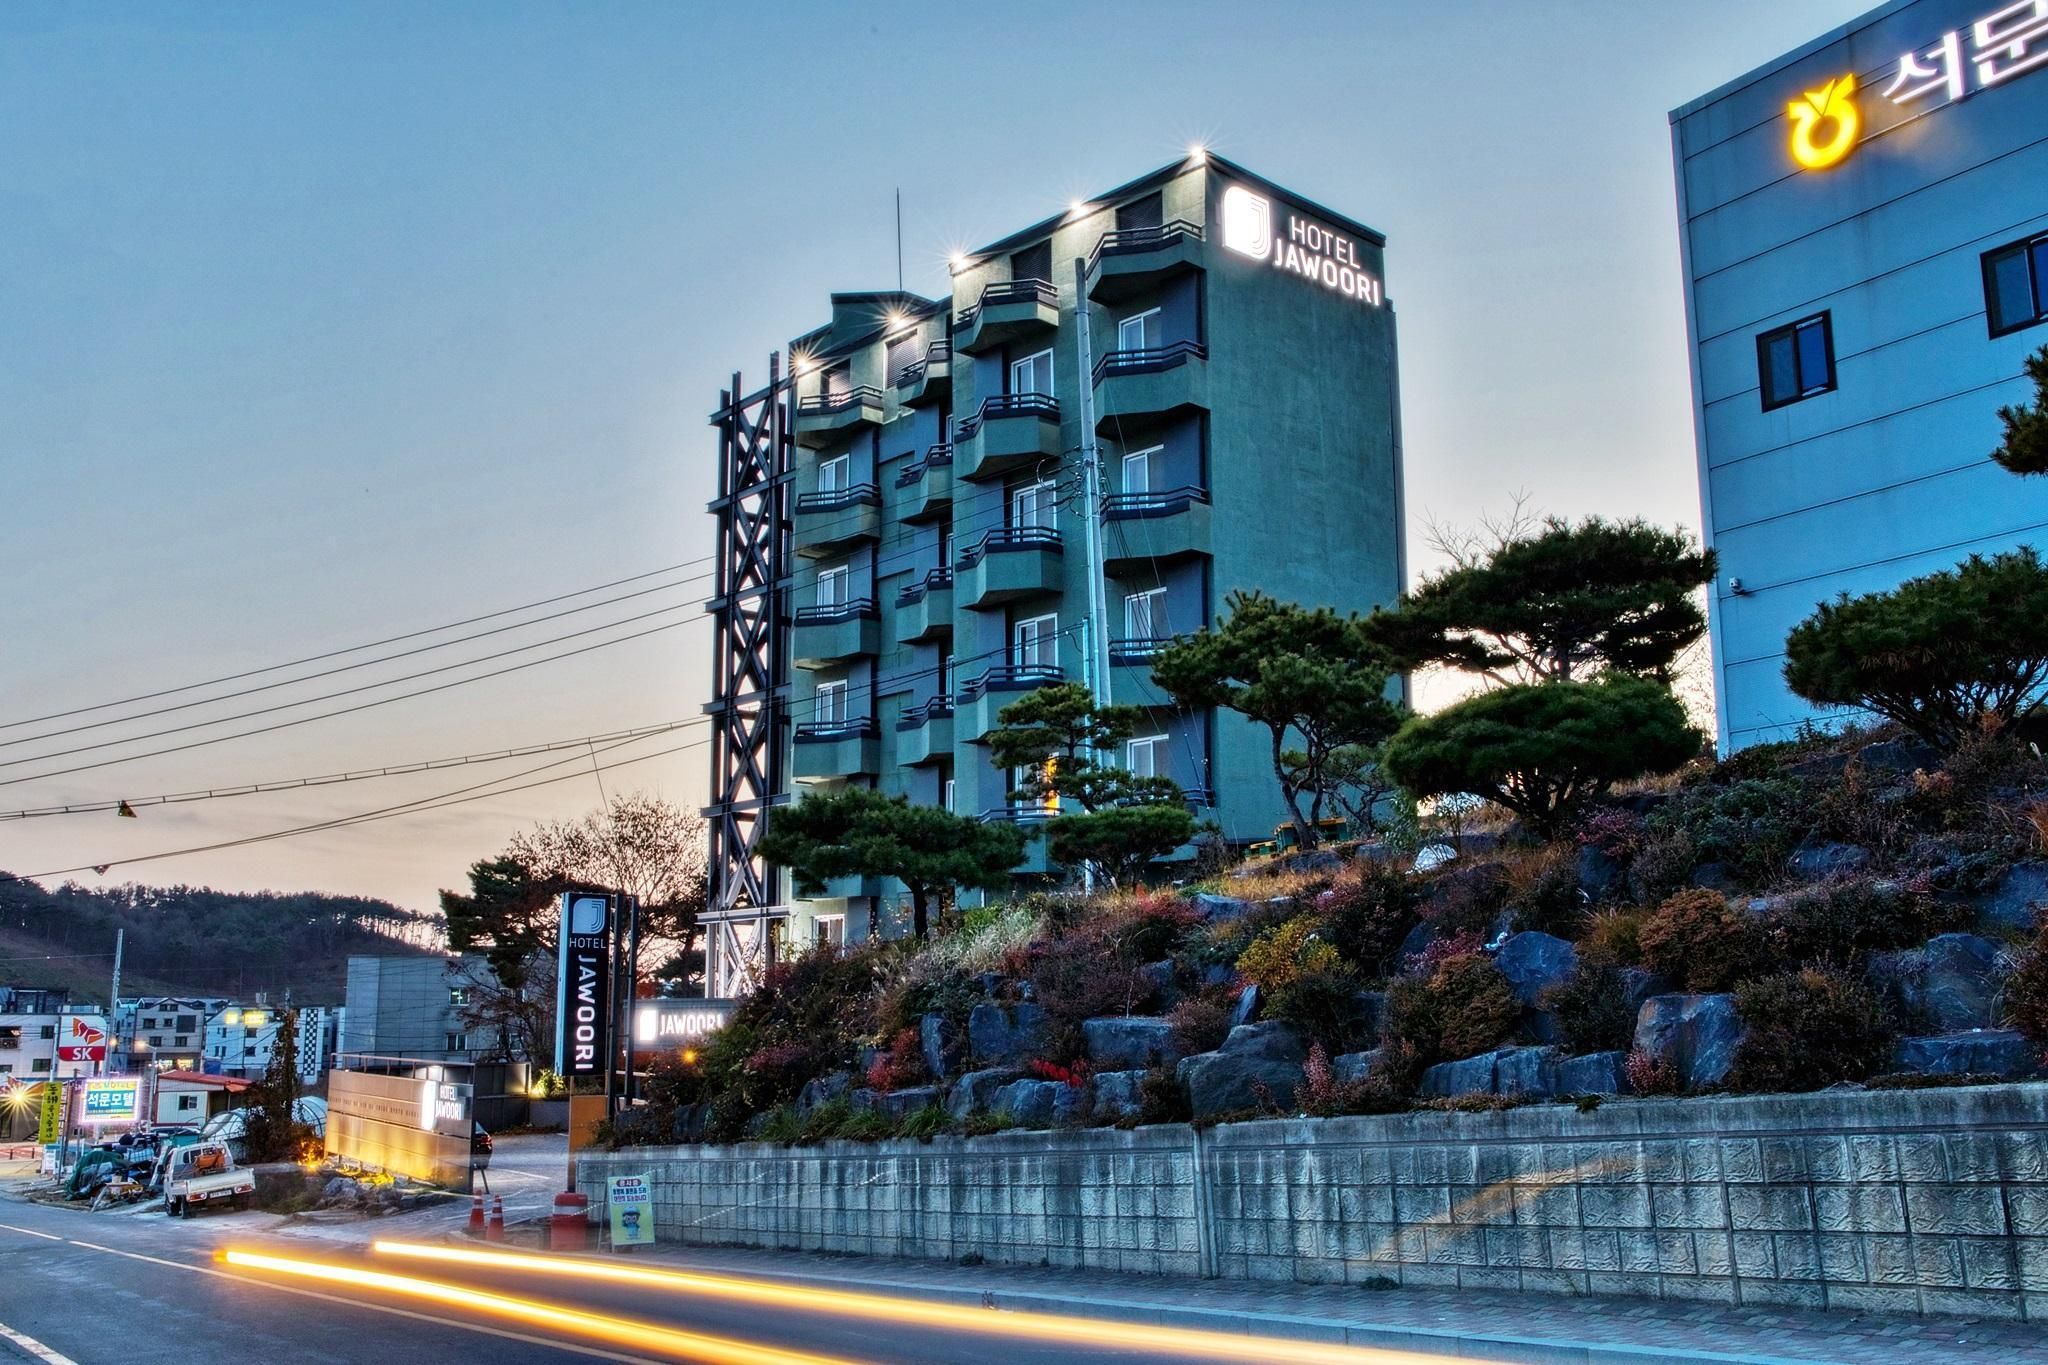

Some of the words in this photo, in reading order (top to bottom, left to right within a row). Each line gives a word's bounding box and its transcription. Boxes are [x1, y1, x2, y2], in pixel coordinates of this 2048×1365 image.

[1290, 215, 1361, 269] HOTEL
[1273, 237, 1380, 306] JAWOORI
[569, 937, 607, 949] HOTEL
[575, 954, 597, 1070] JAWOORI
[72, 1047, 92, 1060] SK
[88, 1092, 134, 1107] 석문모텔
[440, 1085, 457, 1101] HOTEL
[435, 1100, 462, 1120] JAWOORI
